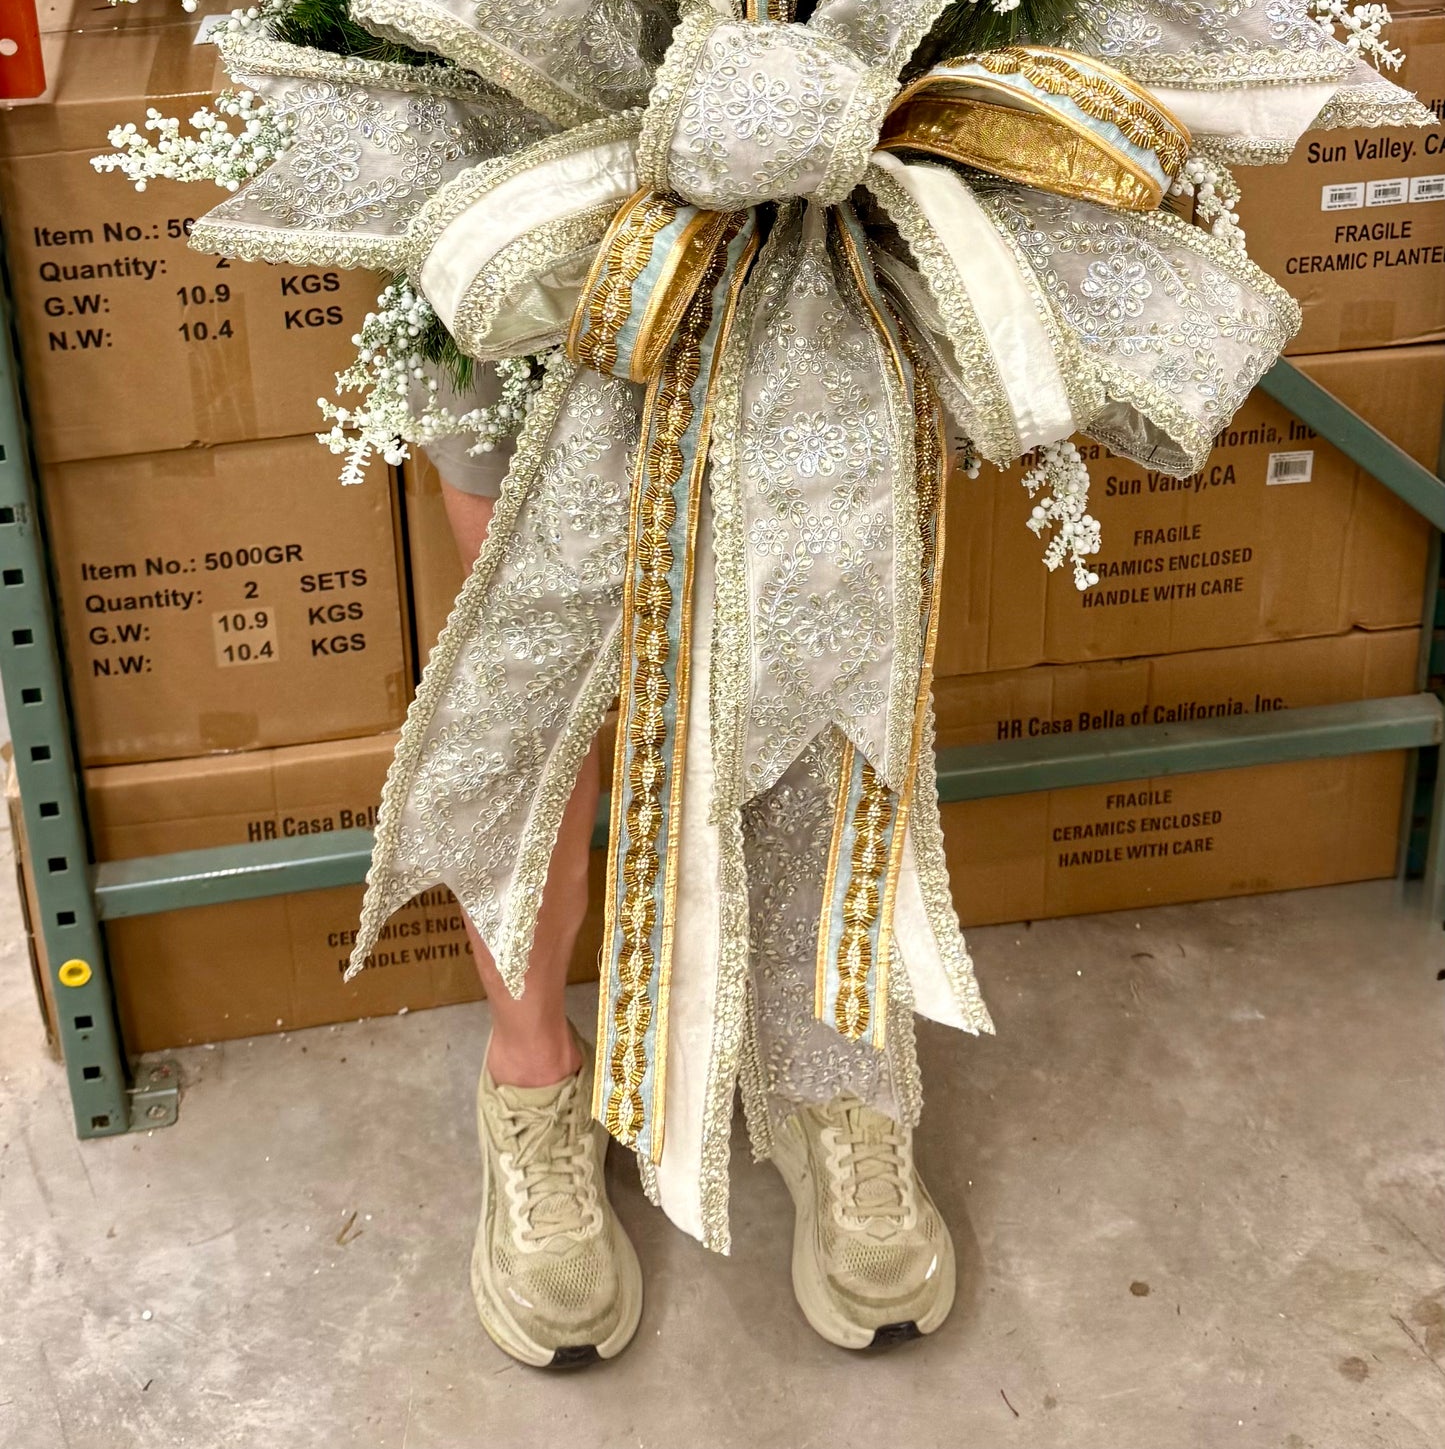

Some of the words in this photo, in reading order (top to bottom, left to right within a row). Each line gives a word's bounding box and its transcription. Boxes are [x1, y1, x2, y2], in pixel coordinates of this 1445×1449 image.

[1307, 142, 1347, 164] Sun
[34, 227, 94, 247] Item
[103, 222, 159, 243] No.:
[1335, 221, 1412, 243] FRAGILE
[40, 257, 167, 282] Quantity:
[1286, 252, 1368, 274] CERAMIC
[1373, 246, 1445, 268] PLANTE
[44, 294, 110, 317] G.W:
[176, 283, 231, 306] 10.9
[281, 272, 340, 296] KGS
[48, 328, 112, 351] N.W:
[178, 319, 234, 342] 10.4
[284, 306, 343, 329] KGS
[1105, 476, 1141, 497] Sun
[1133, 524, 1202, 546] FRAGILE
[81, 563, 137, 581] Item
[145, 557, 196, 576] No.:
[204, 544, 304, 571] 5000GR
[1082, 558, 1165, 578] ERAMICS
[1169, 547, 1253, 571] ENCLOSED
[85, 589, 202, 613] Quantity:
[244, 581, 259, 599] 2
[300, 568, 368, 593] SETS
[1082, 587, 1150, 608] HANDLE
[1153, 582, 1197, 601] WITH
[1201, 577, 1244, 596] CARE
[89, 624, 150, 645] G.W:
[218, 611, 268, 633] 10.9
[308, 602, 364, 626] KGS
[93, 655, 151, 677] N.W:
[224, 640, 274, 662] 10.4
[311, 633, 366, 657] KGS
[997, 719, 1022, 740] HR
[1028, 717, 1073, 736] Casa
[1078, 710, 1125, 731] Bella
[1131, 704, 1149, 725] of
[1255, 694, 1288, 712] Inc.
[1106, 789, 1173, 810] FRAGILE
[247, 820, 277, 843] HR
[283, 816, 334, 838] Casa
[1053, 819, 1136, 842] CERAMICS
[1141, 810, 1222, 832] ENCLOSED
[1058, 847, 1123, 868] HANDLE
[1126, 842, 1168, 860] WITH
[1172, 837, 1214, 856] CARE
[338, 949, 410, 973] HNDLE
[414, 943, 459, 961] WITH
